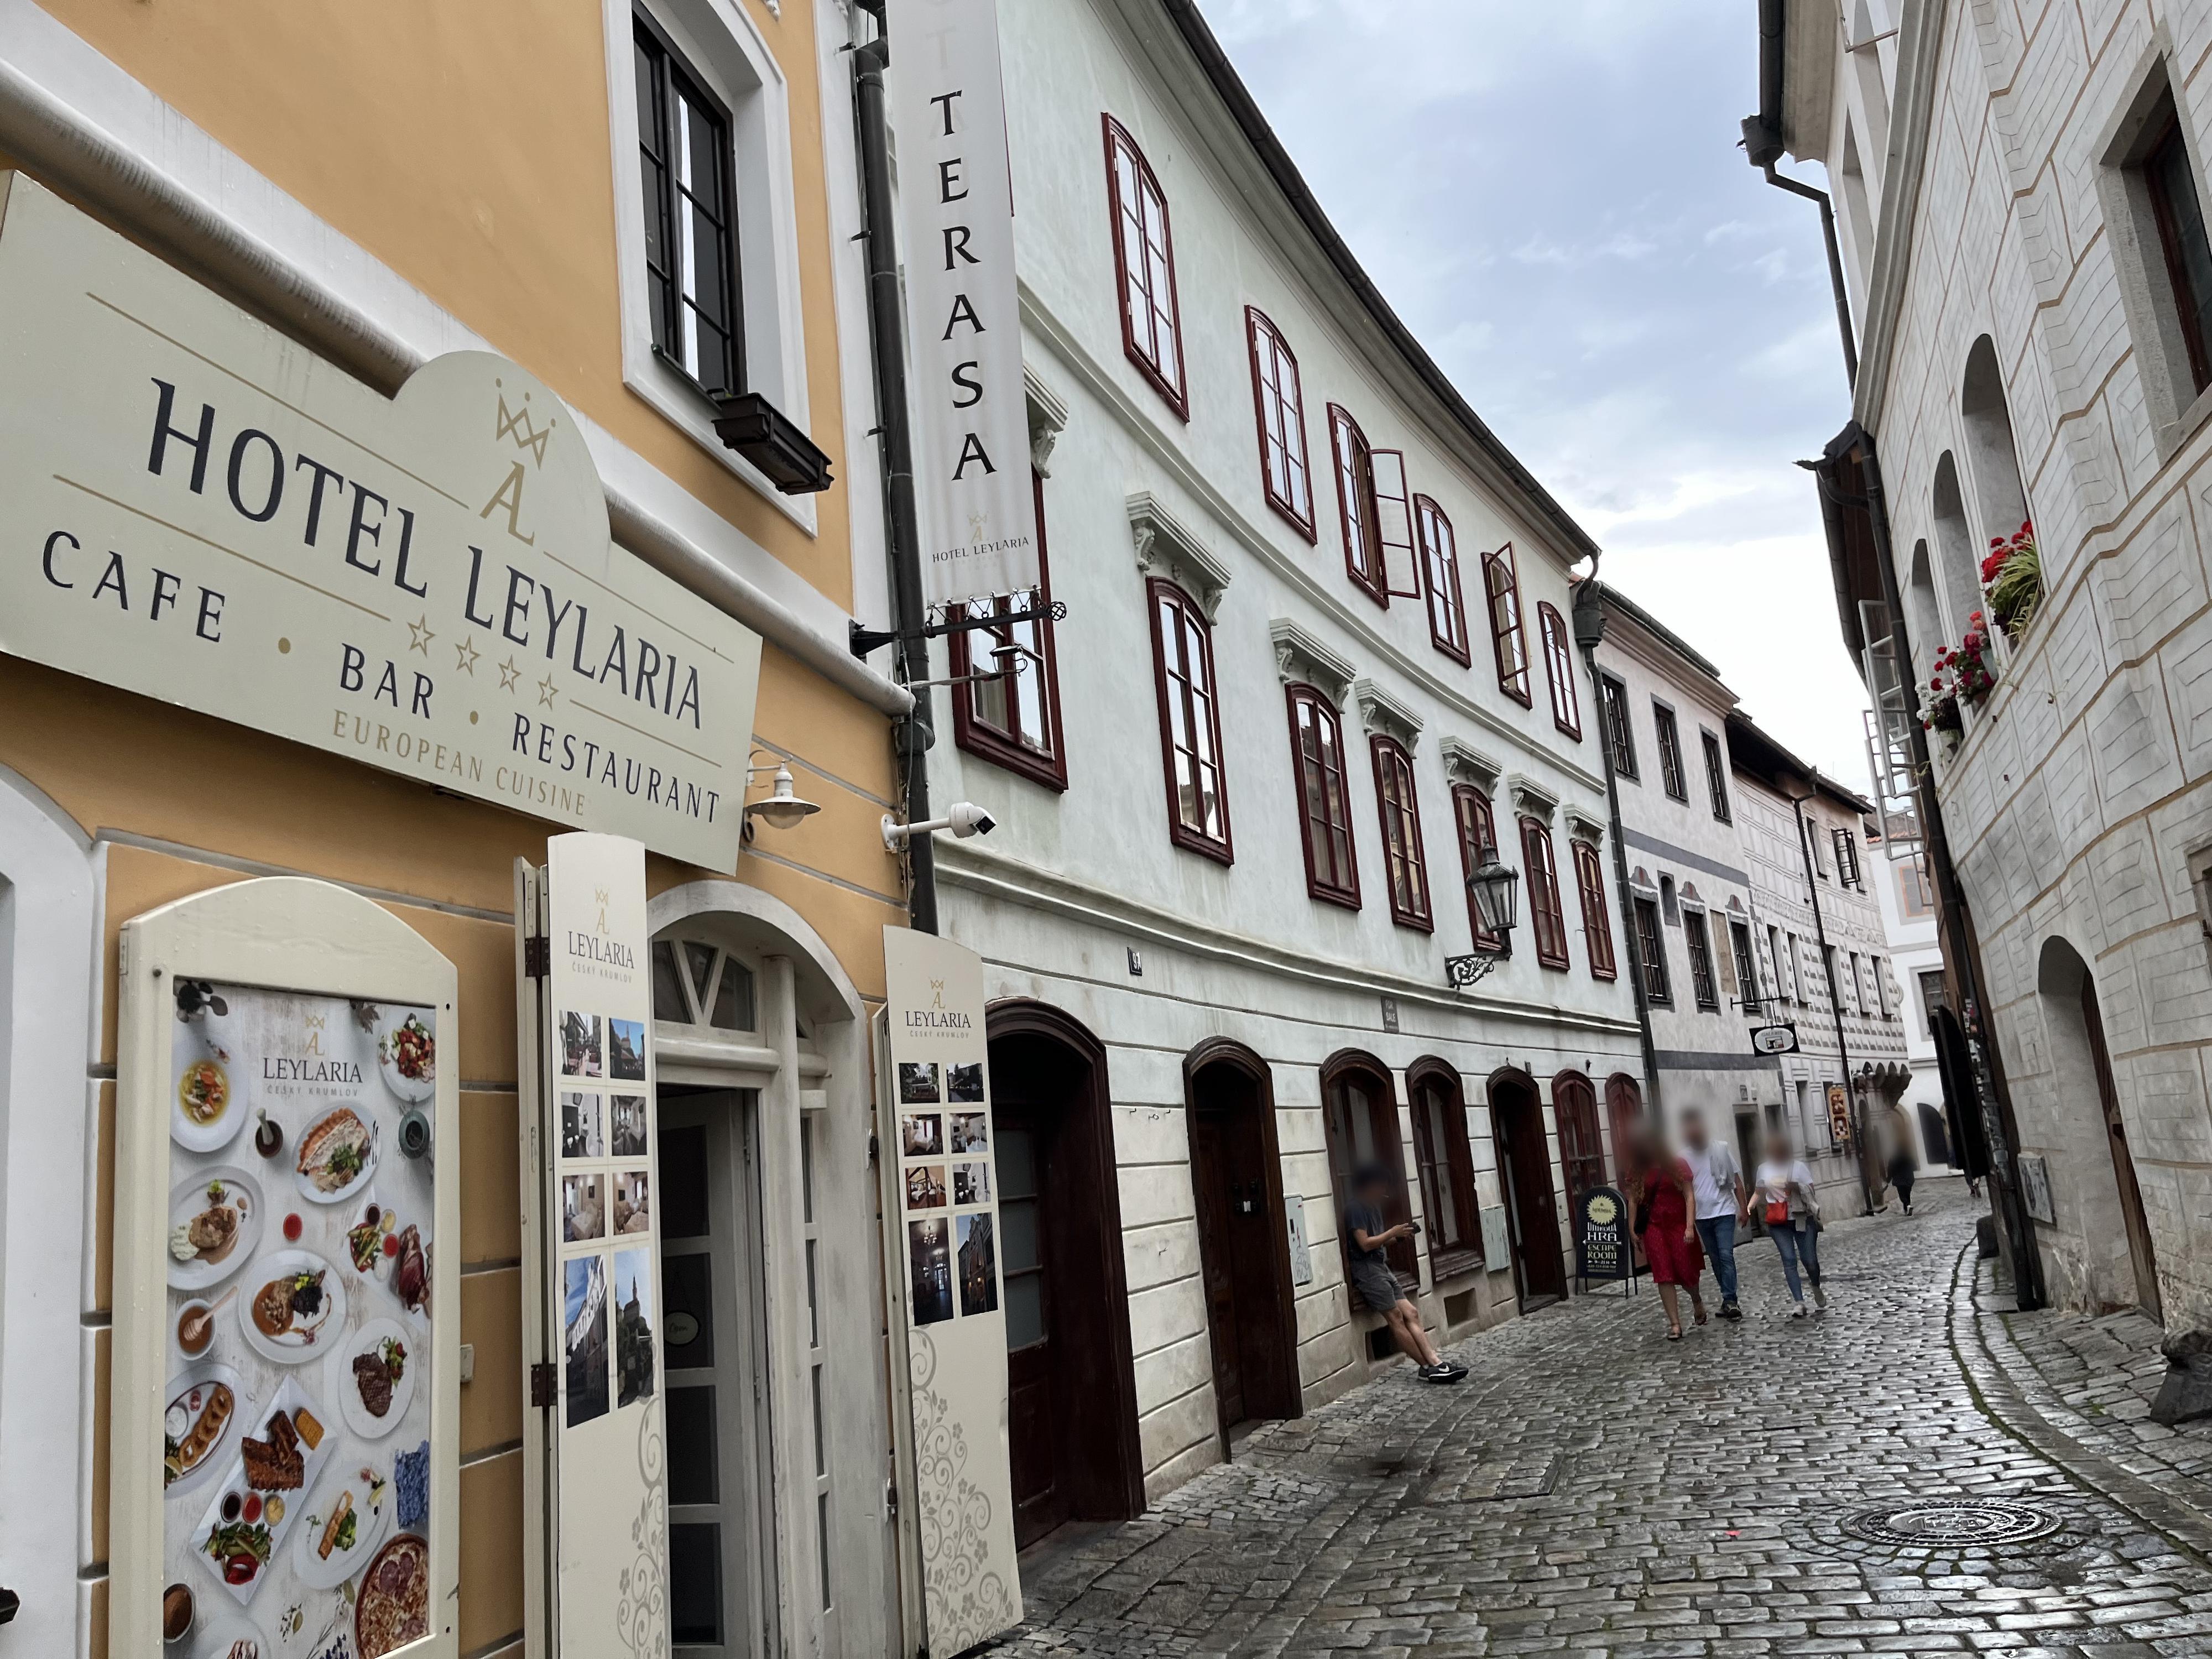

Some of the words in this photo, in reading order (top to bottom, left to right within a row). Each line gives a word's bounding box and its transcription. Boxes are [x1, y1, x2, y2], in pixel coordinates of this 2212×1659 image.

[930, 89, 998, 481] TERASA
[147, 377, 427, 598] HOTEL
[465, 545, 701, 731] LEYLARIA
[932, 547, 969, 563] HOTEL
[973, 536, 1030, 555] LEYLARIA
[43, 530, 226, 643] CAFE
[340, 643, 434, 719] BAR
[512, 712, 719, 823] RESTAURANT
[333, 708, 483, 782] EUROPEAN
[495, 766, 586, 817] CUISINE
[567, 930, 635, 969] LEYLARIA
[600, 969, 632, 983] KRUMLOV
[905, 1010, 972, 1028] LEYLARIA
[263, 1057, 363, 1084] LEYLARIA
[309, 1087, 358, 1097] KRUMLOV
[1587, 1232, 1617, 1241] HRA
[1587, 1251, 1617, 1259] ROOM
